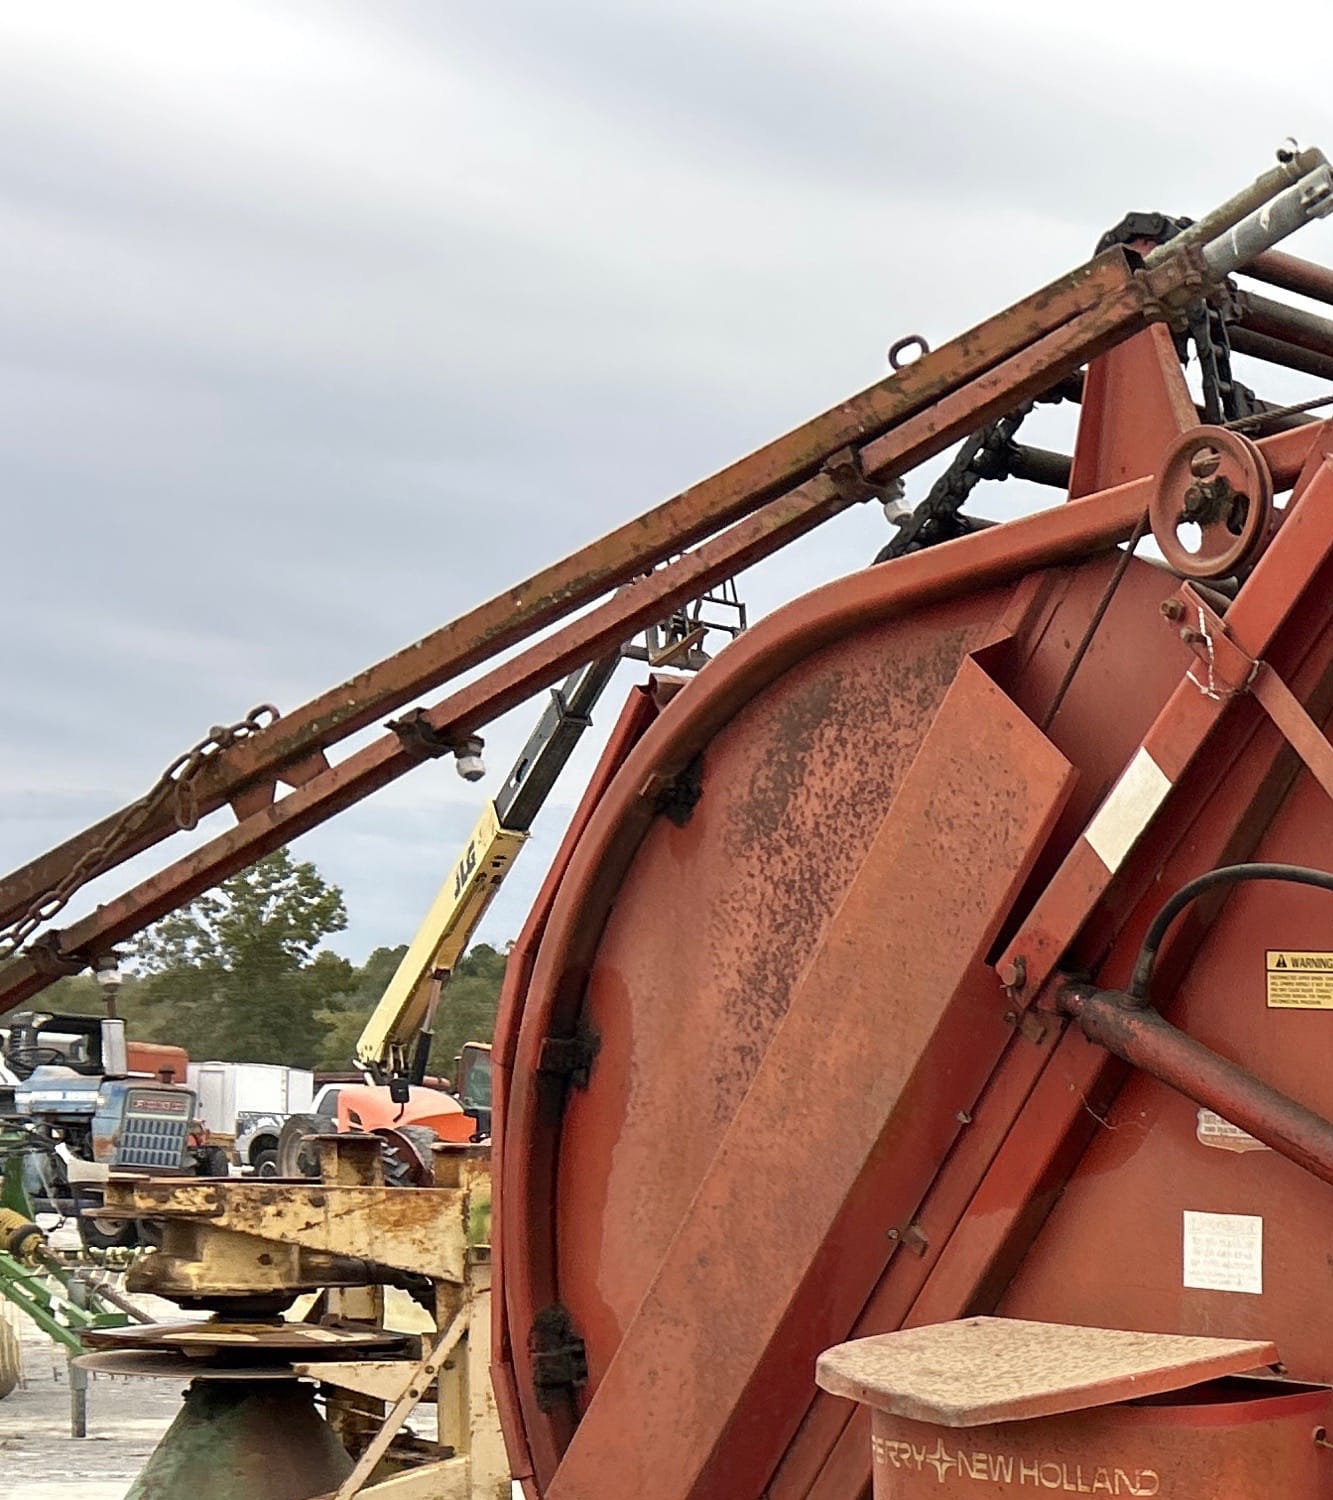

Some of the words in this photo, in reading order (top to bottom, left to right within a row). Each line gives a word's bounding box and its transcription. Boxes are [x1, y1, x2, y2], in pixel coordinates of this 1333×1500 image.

[455, 840, 476, 900] JLG
[1290, 957, 1333, 969] WARNING
[958, 1451, 1013, 1483] NEW
[1019, 1459, 1160, 1497] HOLLAND
